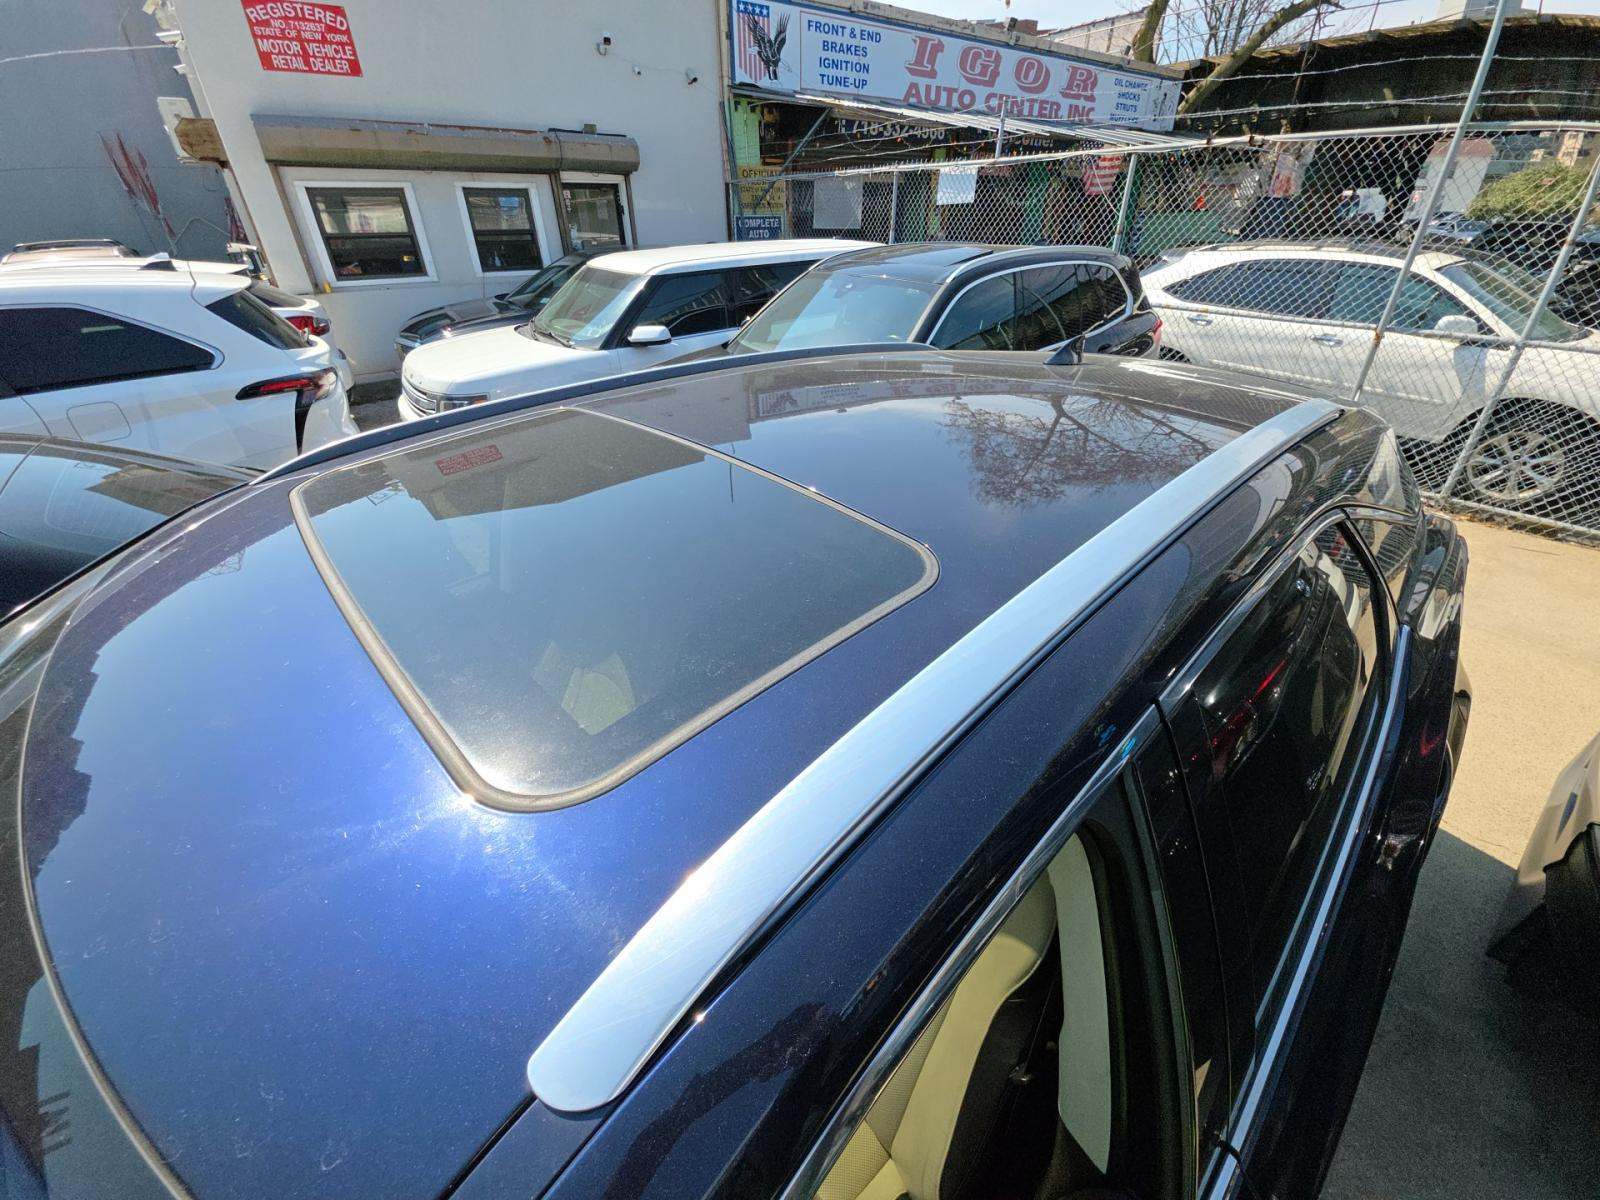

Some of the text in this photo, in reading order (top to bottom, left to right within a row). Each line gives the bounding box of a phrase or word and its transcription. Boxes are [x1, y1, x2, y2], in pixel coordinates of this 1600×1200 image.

[246, 3, 348, 31] REGISTERED
[253, 26, 350, 44] STATE OF NEW YORK
[807, 19, 882, 43] FRONT & END
[257, 38, 355, 60] MOTOR VEHICLE
[822, 40, 868, 58] BRAKES
[271, 54, 350, 73] RETAIL DEALER
[818, 57, 870, 74] IGNITION
[904, 35, 1099, 103] IGOR
[819, 73, 868, 90] TUNE-UP
[1114, 78, 1124, 88] OIL
[902, 82, 977, 110] AUTO
[1115, 102, 1138, 113] STRUTS
[749, 229, 770, 239] AUTO
